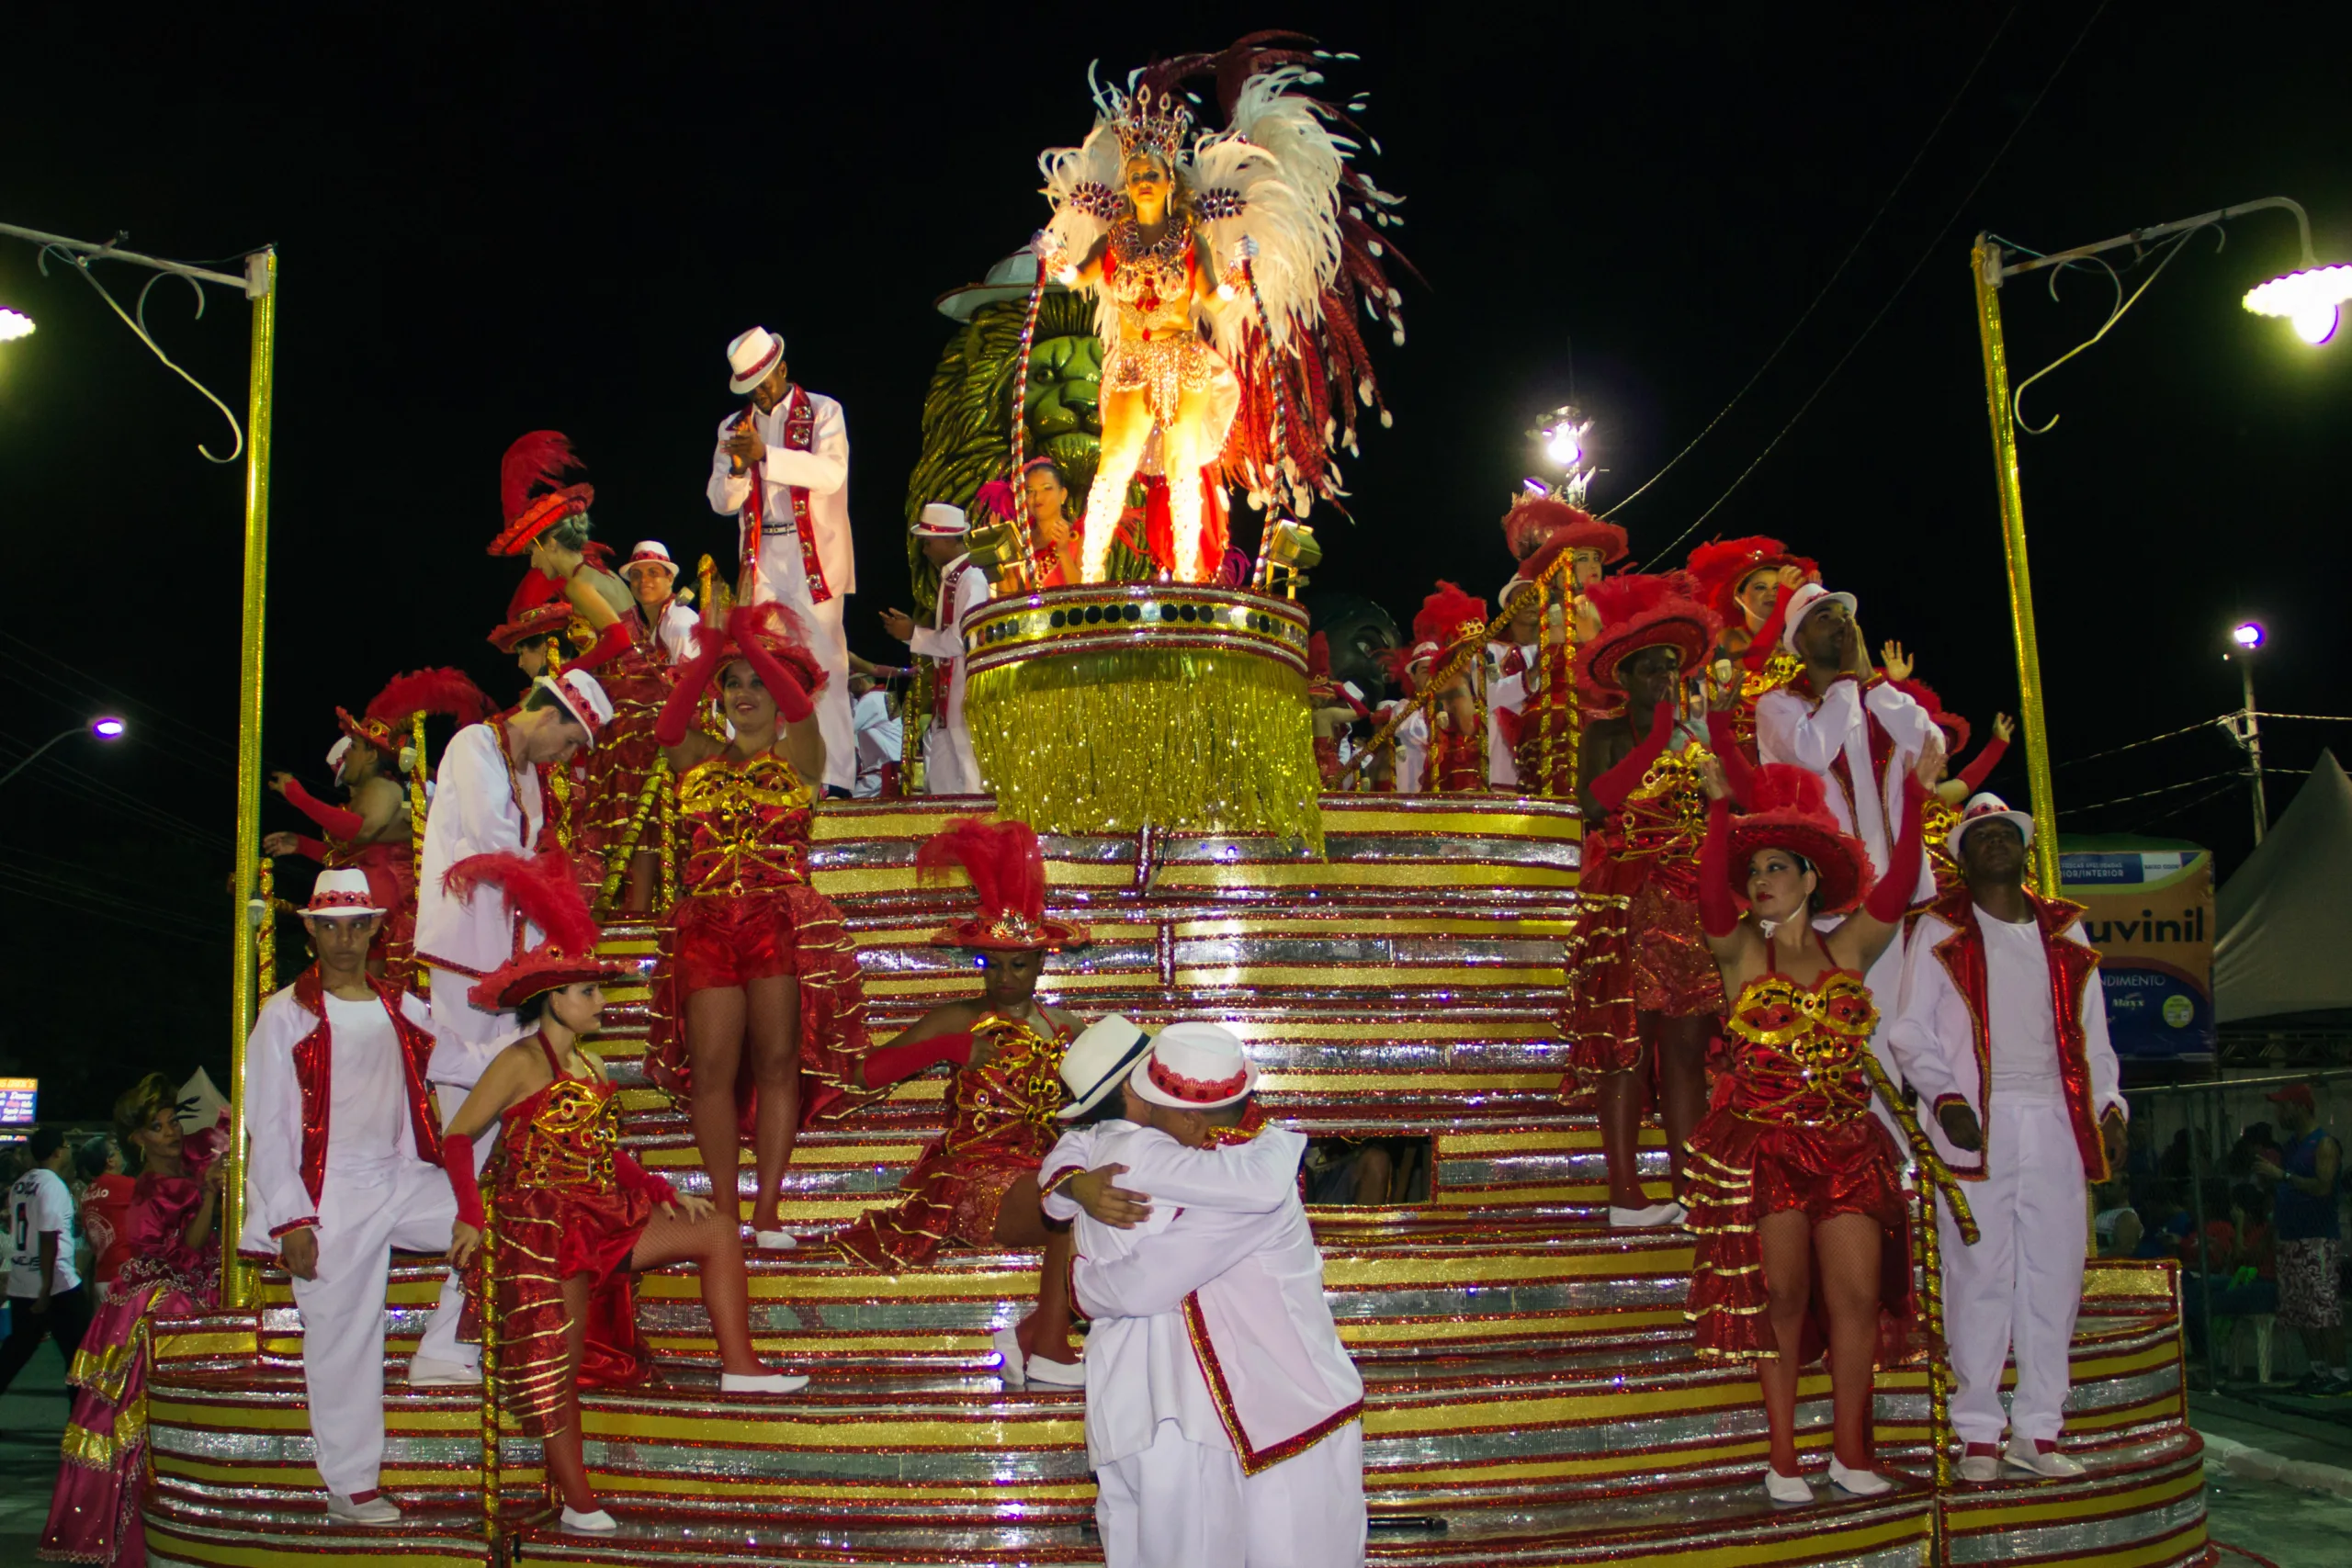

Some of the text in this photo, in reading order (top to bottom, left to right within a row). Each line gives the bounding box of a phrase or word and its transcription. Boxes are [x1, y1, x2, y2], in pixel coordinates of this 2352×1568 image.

[2061, 869, 2124, 878] IOR/INTERIOR
[2085, 906, 2204, 943] uvinil
[2100, 975, 2166, 987] NDIMENTO
